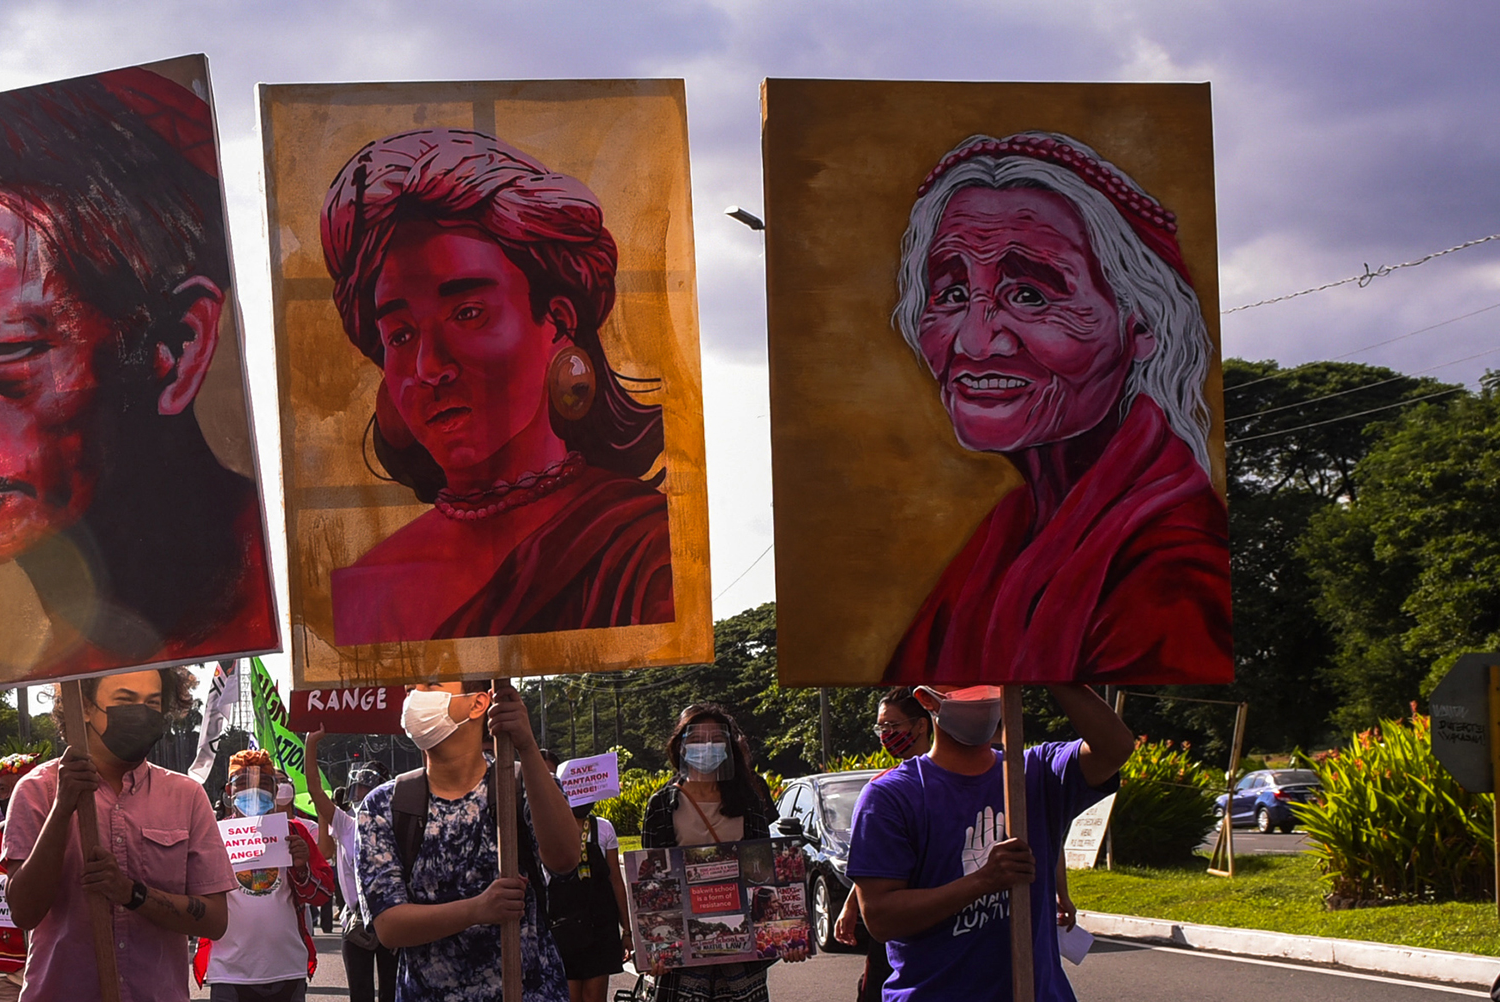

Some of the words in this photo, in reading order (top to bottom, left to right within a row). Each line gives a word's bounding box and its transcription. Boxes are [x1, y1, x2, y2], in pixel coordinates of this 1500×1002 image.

[307, 687, 388, 712] RANGE
[570, 765, 594, 776] SAVE
[561, 772, 609, 786] PANTARON
[566, 785, 598, 797] RANGE!
[227, 825, 257, 835] SAVE
[225, 836, 278, 848] ANTARON
[230, 850, 264, 860] ANGE!
[691, 887, 714, 895] bakwit
[714, 884, 736, 893] school
[708, 893, 724, 901] form
[700, 901, 732, 909] resistance
